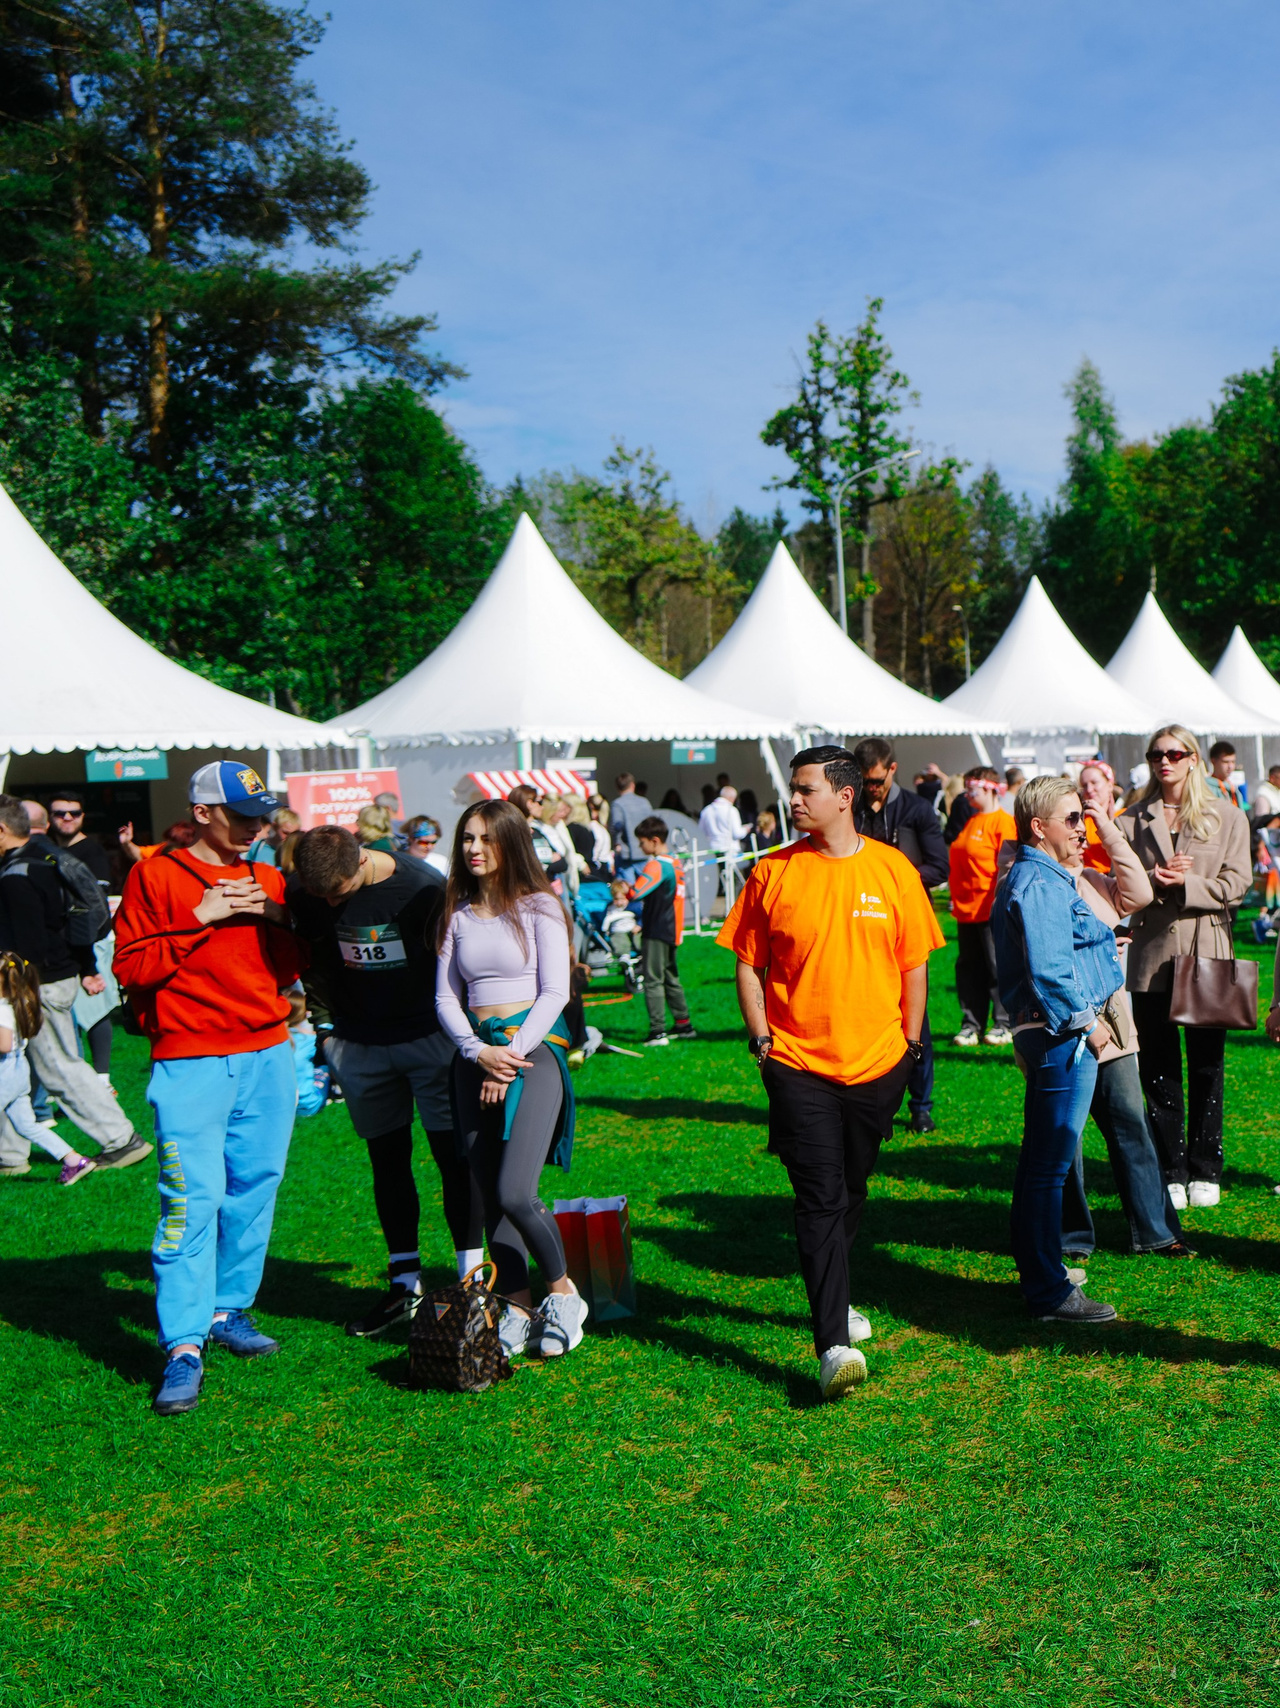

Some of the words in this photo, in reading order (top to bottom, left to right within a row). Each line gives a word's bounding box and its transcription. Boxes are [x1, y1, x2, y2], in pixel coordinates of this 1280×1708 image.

[328, 786, 372, 801] 100%
[351, 946, 386, 960] 318
[162, 1141, 187, 1192] JEANS
[159, 1197, 187, 1251] TOMMY
